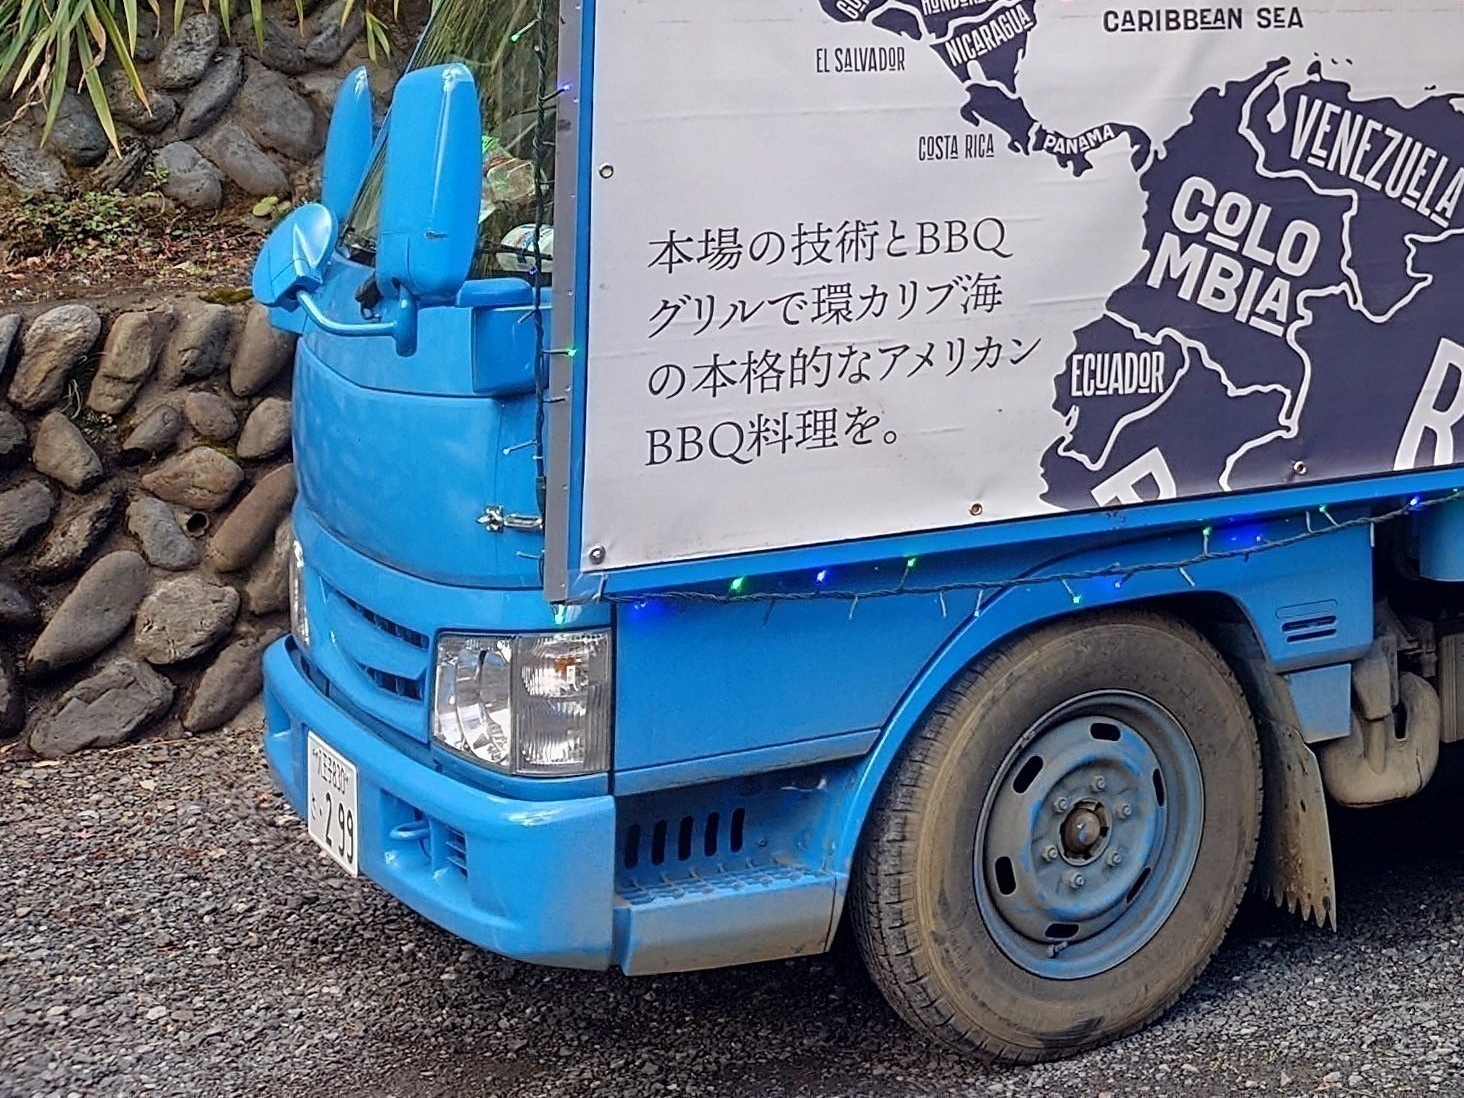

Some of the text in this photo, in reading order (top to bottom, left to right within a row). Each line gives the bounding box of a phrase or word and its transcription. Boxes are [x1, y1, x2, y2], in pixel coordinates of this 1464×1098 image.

[944, 3, 1034, 67] NICARAGUA
[1103, 6, 1304, 32] CARIBBEAN SEA
[816, 47, 905, 73] EL SALVADOR
[919, 133, 995, 161] COSTA RICA
[1042, 124, 1116, 155] PANAMA
[647, 216, 1013, 274] 本場の技術とBBQ
[1170, 176, 1321, 277] COLO
[648, 272, 1003, 339] グリルで環カリブ海
[1146, 232, 1294, 338] MBIA
[648, 336, 1042, 400] の本格的なアメリカン
[1071, 350, 1165, 398] ECUADOR
